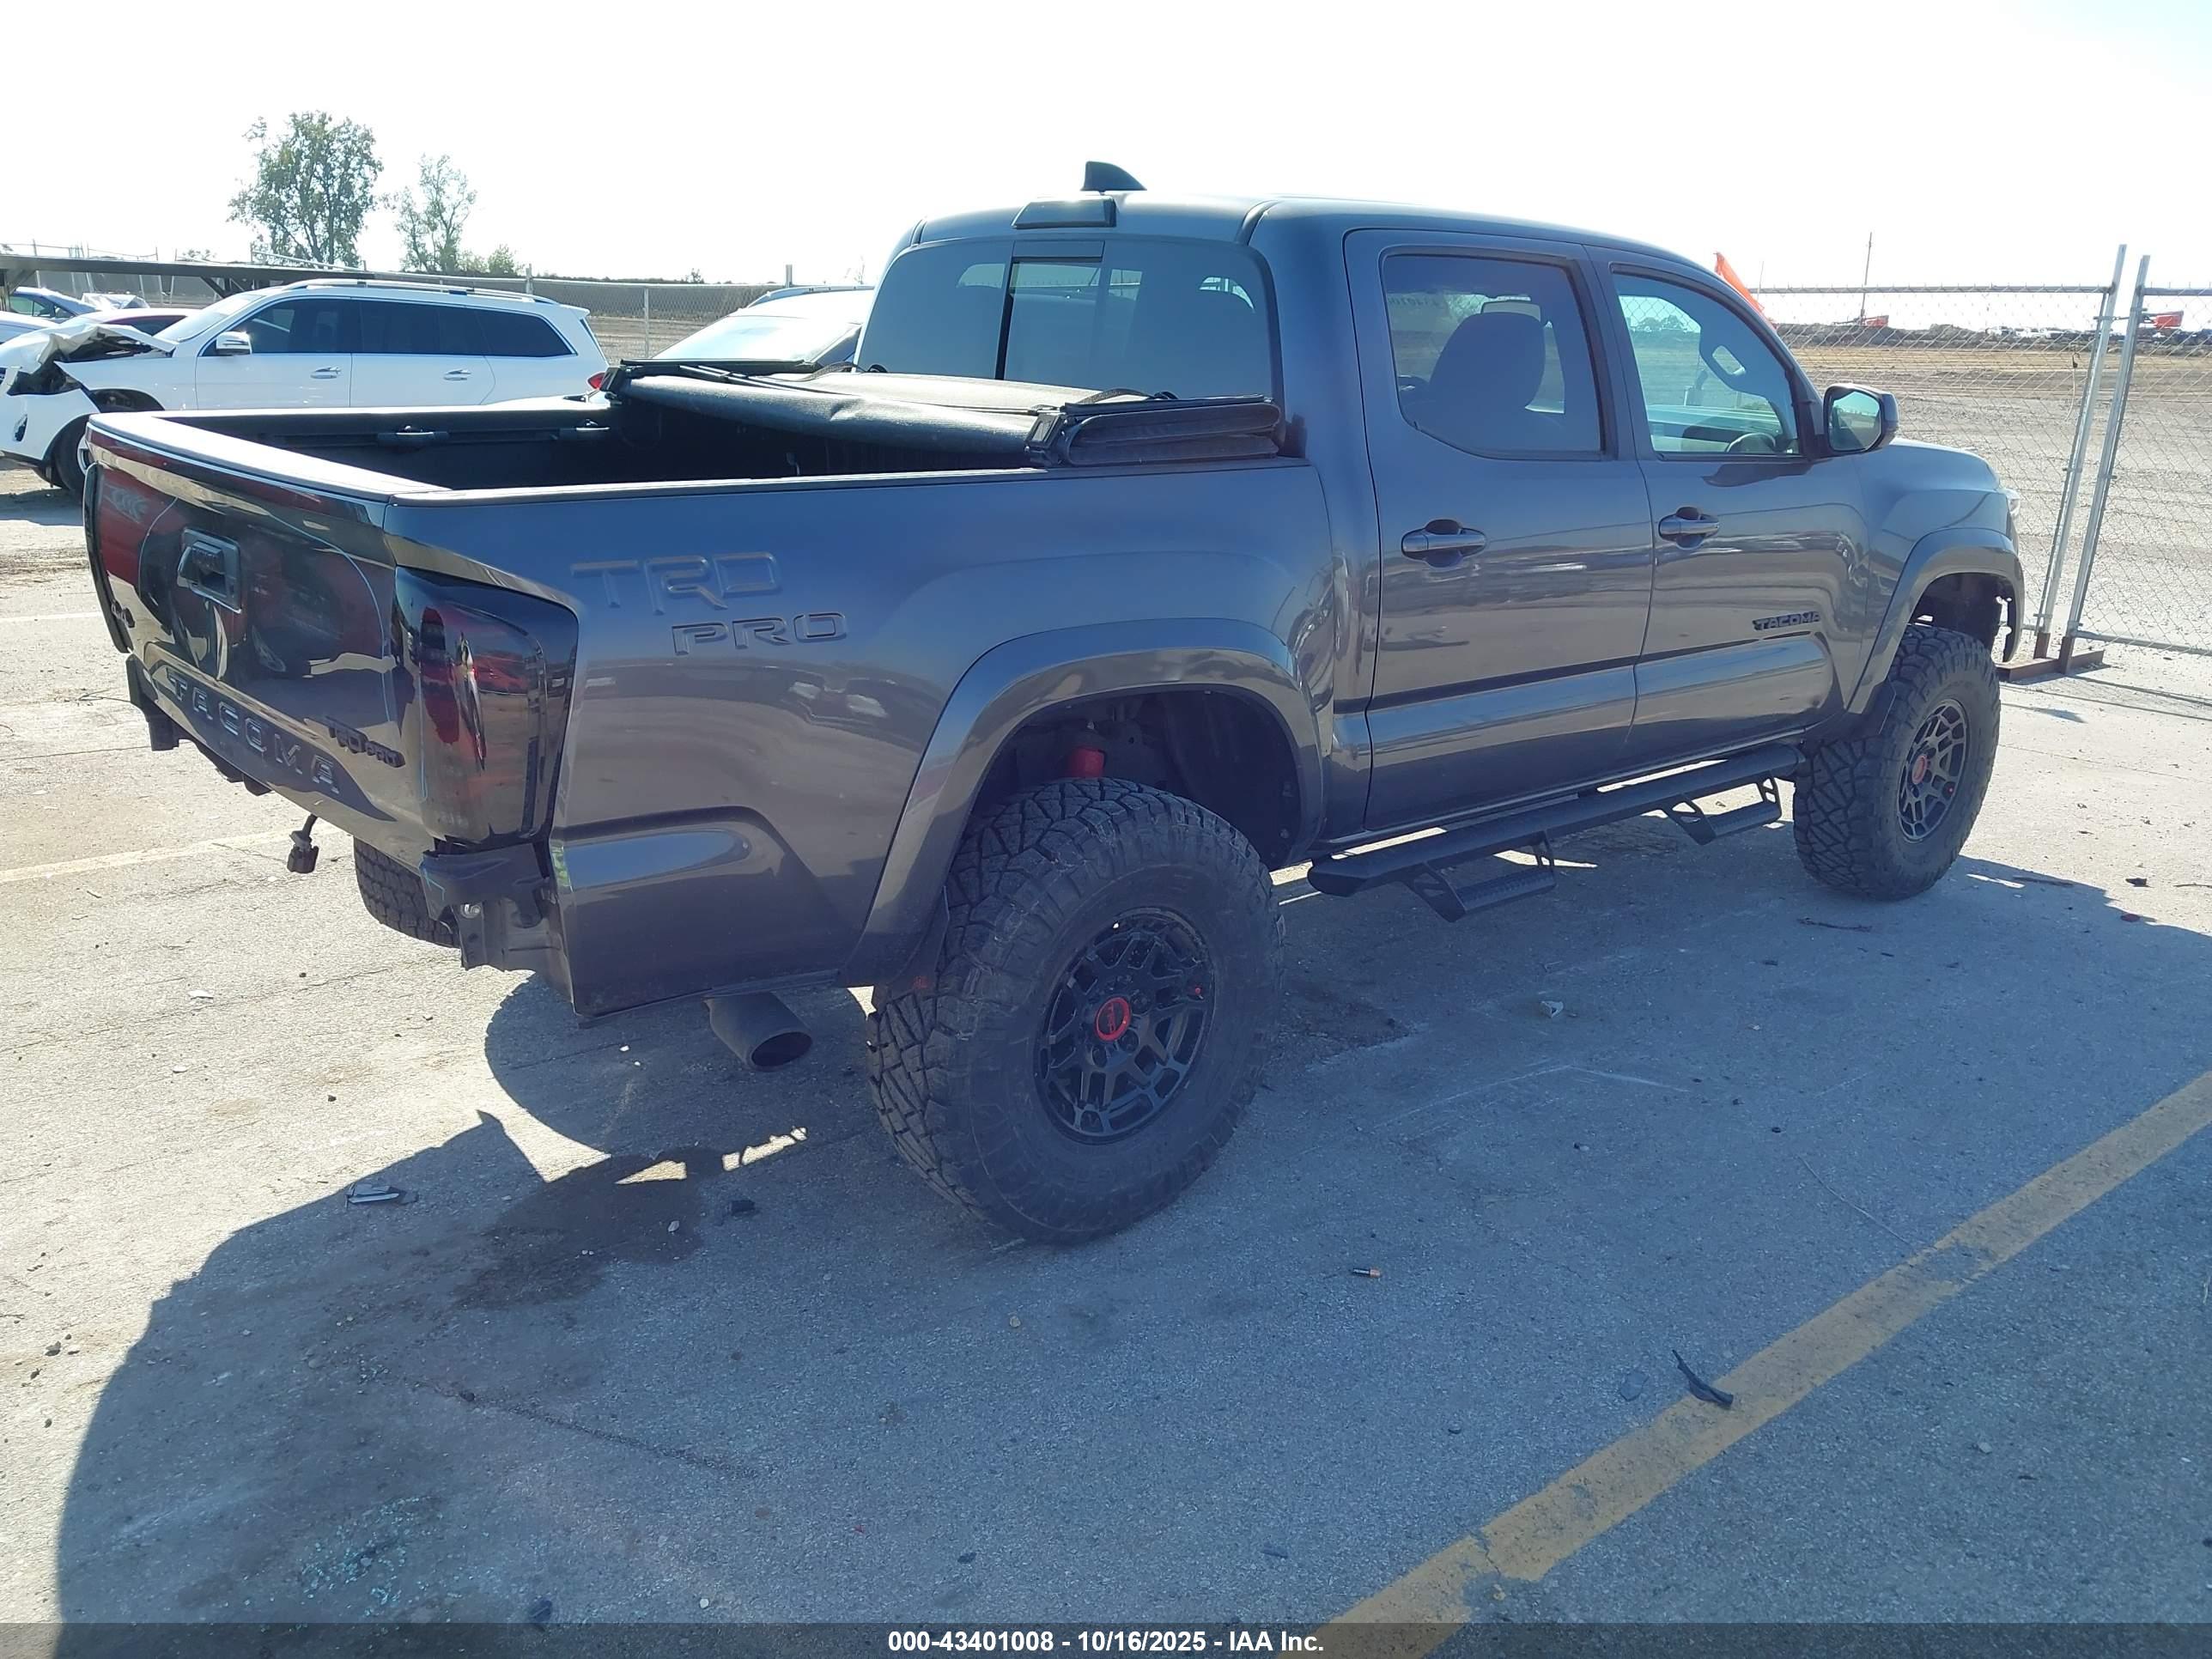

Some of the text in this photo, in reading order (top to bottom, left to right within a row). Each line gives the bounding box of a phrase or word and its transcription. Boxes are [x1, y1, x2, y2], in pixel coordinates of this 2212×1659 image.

[571, 552, 781, 615] TRD
[672, 611, 848, 656] PRO
[1752, 611, 1821, 631] TACOMA
[167, 669, 340, 794] TACOMA
